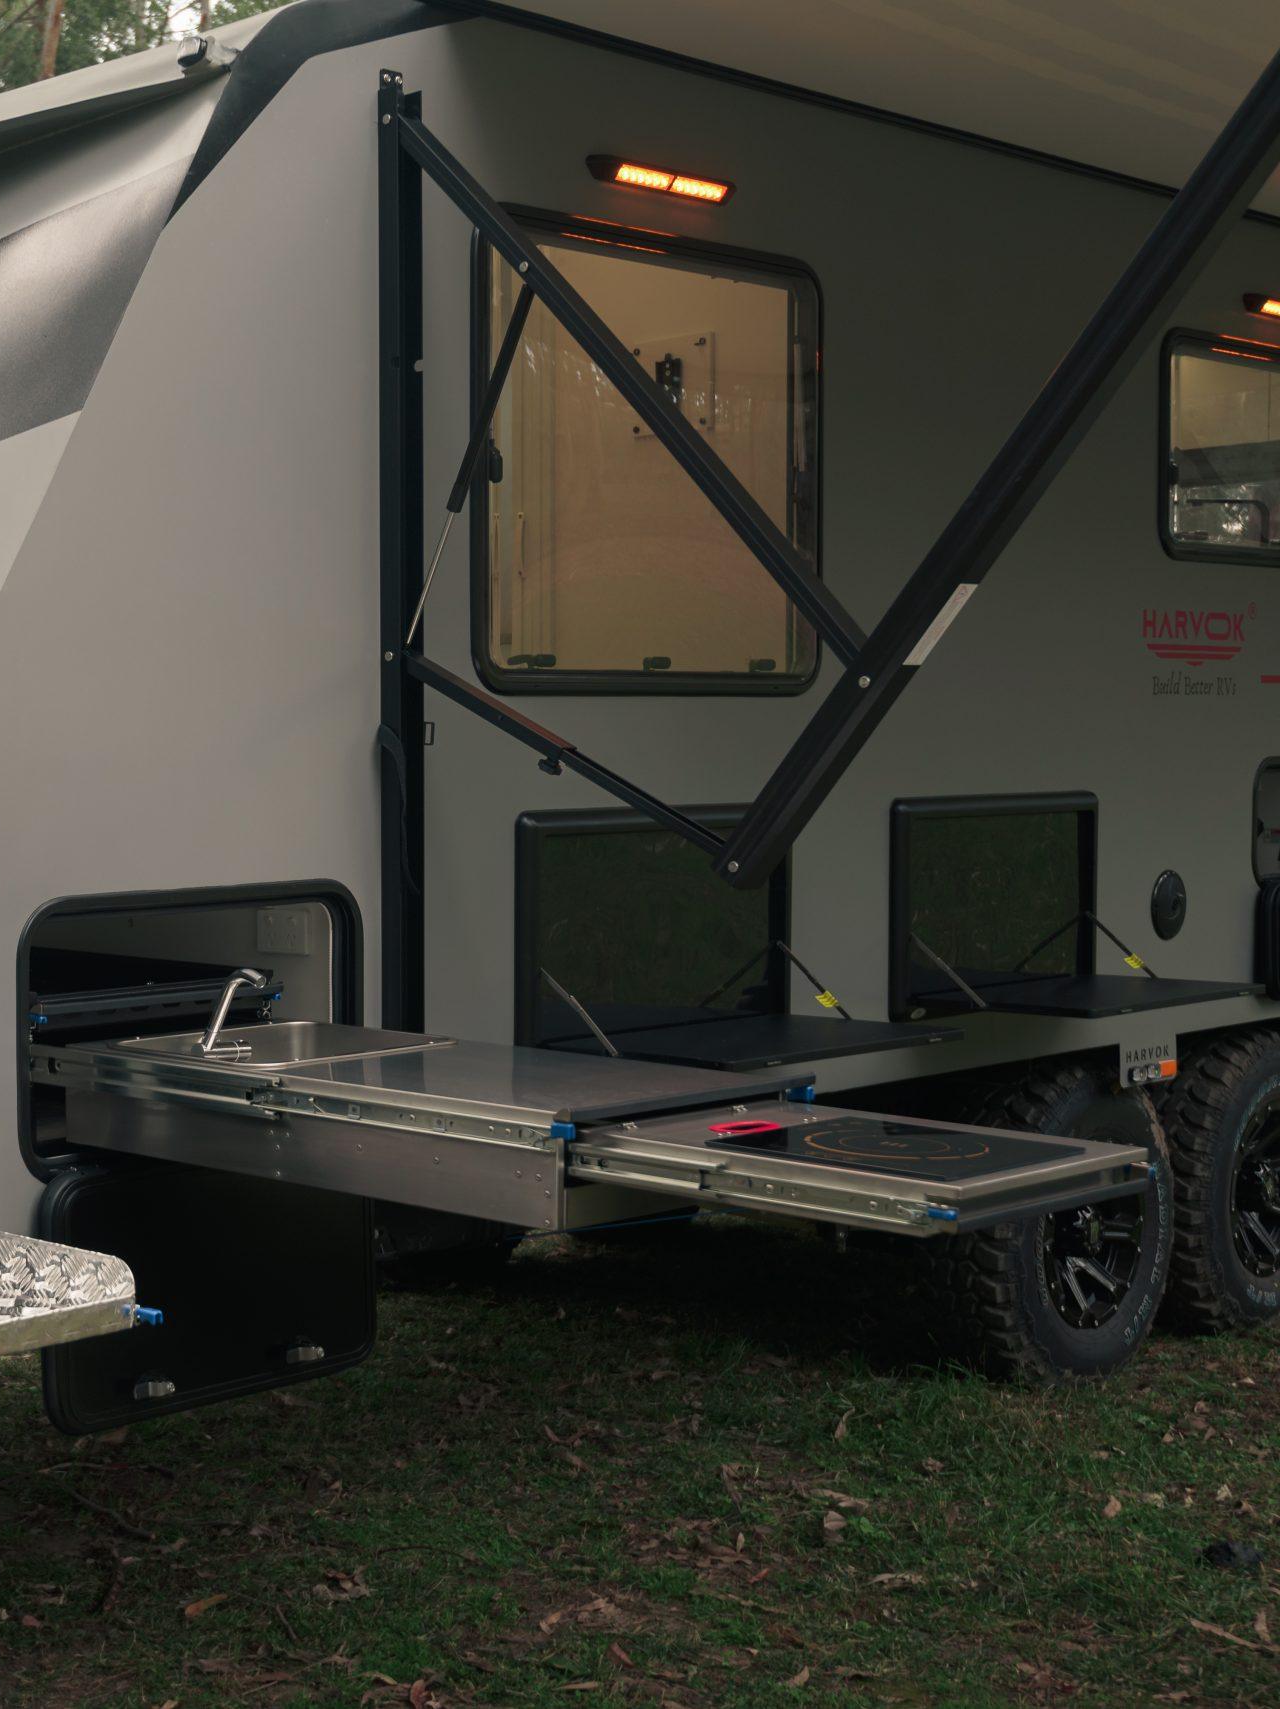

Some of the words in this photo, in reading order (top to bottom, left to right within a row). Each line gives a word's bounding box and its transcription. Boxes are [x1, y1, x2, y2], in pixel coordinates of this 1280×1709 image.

[1142, 608, 1245, 642] HARVOK
[1152, 669, 1182, 696] Build
[1184, 675, 1214, 696] Better
[1216, 676, 1238, 696] RVs
[1125, 1044, 1169, 1064] HARVOK
